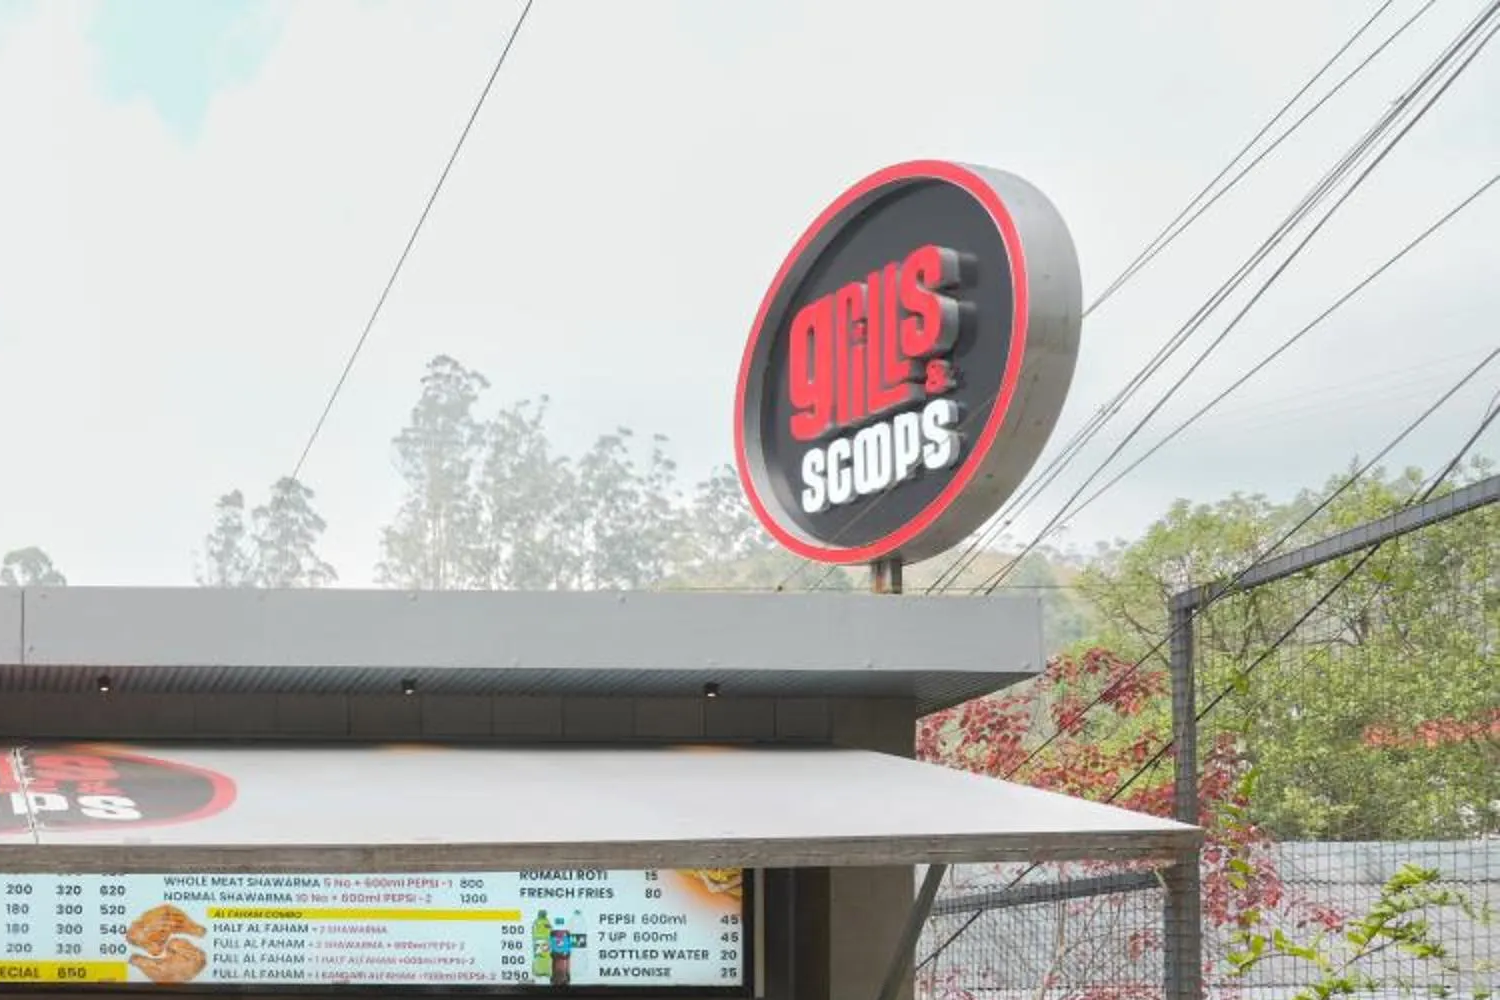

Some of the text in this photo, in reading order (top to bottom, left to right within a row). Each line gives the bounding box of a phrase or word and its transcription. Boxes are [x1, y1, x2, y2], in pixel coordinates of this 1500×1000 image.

[925, 360, 955, 394] &
[519, 870, 572, 880] ROMALI
[577, 870, 608, 880] ROTI
[163, 876, 208, 887] WHOLE
[211, 876, 244, 887] MEAT
[246, 878, 320, 888] SHAWARMA
[6, 884, 32, 895] 200
[56, 884, 82, 896] 320
[520, 888, 662, 899] FRENCH FRIES 80
[163, 891, 216, 901] NORMAL
[219, 892, 292, 902] SHAWARMA
[6, 904, 29, 914] 180
[56, 904, 83, 915] 300
[100, 904, 126, 915] 520
[599, 914, 739, 925] PEPSI 600ml 45
[56, 924, 83, 934] 300
[100, 924, 126, 934] 540
[213, 924, 243, 933] HALF
[247, 924, 260, 933] AL
[264, 924, 308, 933] FAHAM
[501, 925, 525, 935] 500
[598, 932, 739, 942] 7 UP 600ml 45
[213, 939, 239, 948] FULL
[244, 939, 258, 948] AL
[261, 939, 305, 948] FAHAM
[213, 954, 239, 963] FULL
[244, 954, 258, 963] AL
[260, 954, 305, 963] FAHAM
[599, 949, 737, 960] BOTTLED WATER 20
[213, 968, 239, 978] FULL
[244, 968, 258, 978] AL
[260, 968, 304, 978] FAHAM
[599, 967, 671, 977] MAYONISE
